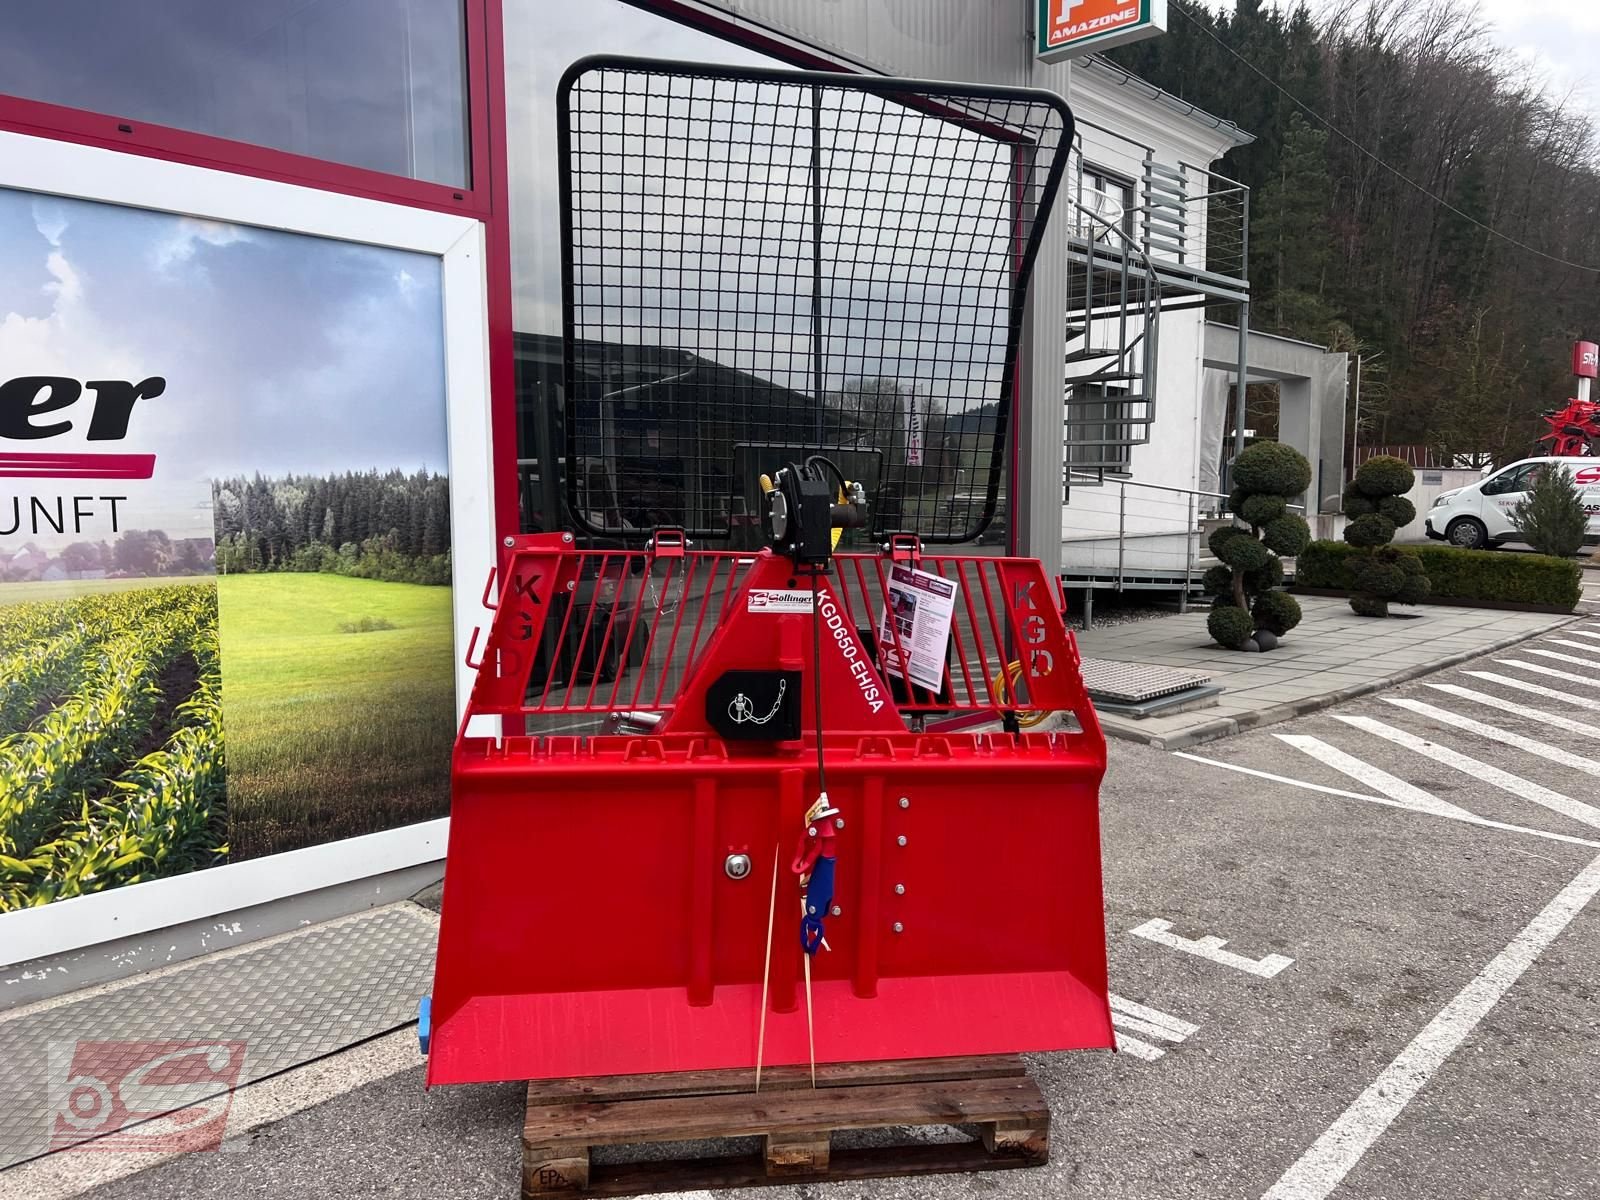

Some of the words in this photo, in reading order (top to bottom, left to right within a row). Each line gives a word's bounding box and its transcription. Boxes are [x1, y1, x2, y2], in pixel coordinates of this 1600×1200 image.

[1050, 8, 1136, 41] AMAZONE
[0, 375, 167, 442] er
[768, 593, 813, 604] Sollinger
[1015, 581, 1054, 678] KGD
[816, 588, 885, 714] KGD650-EH/SA
